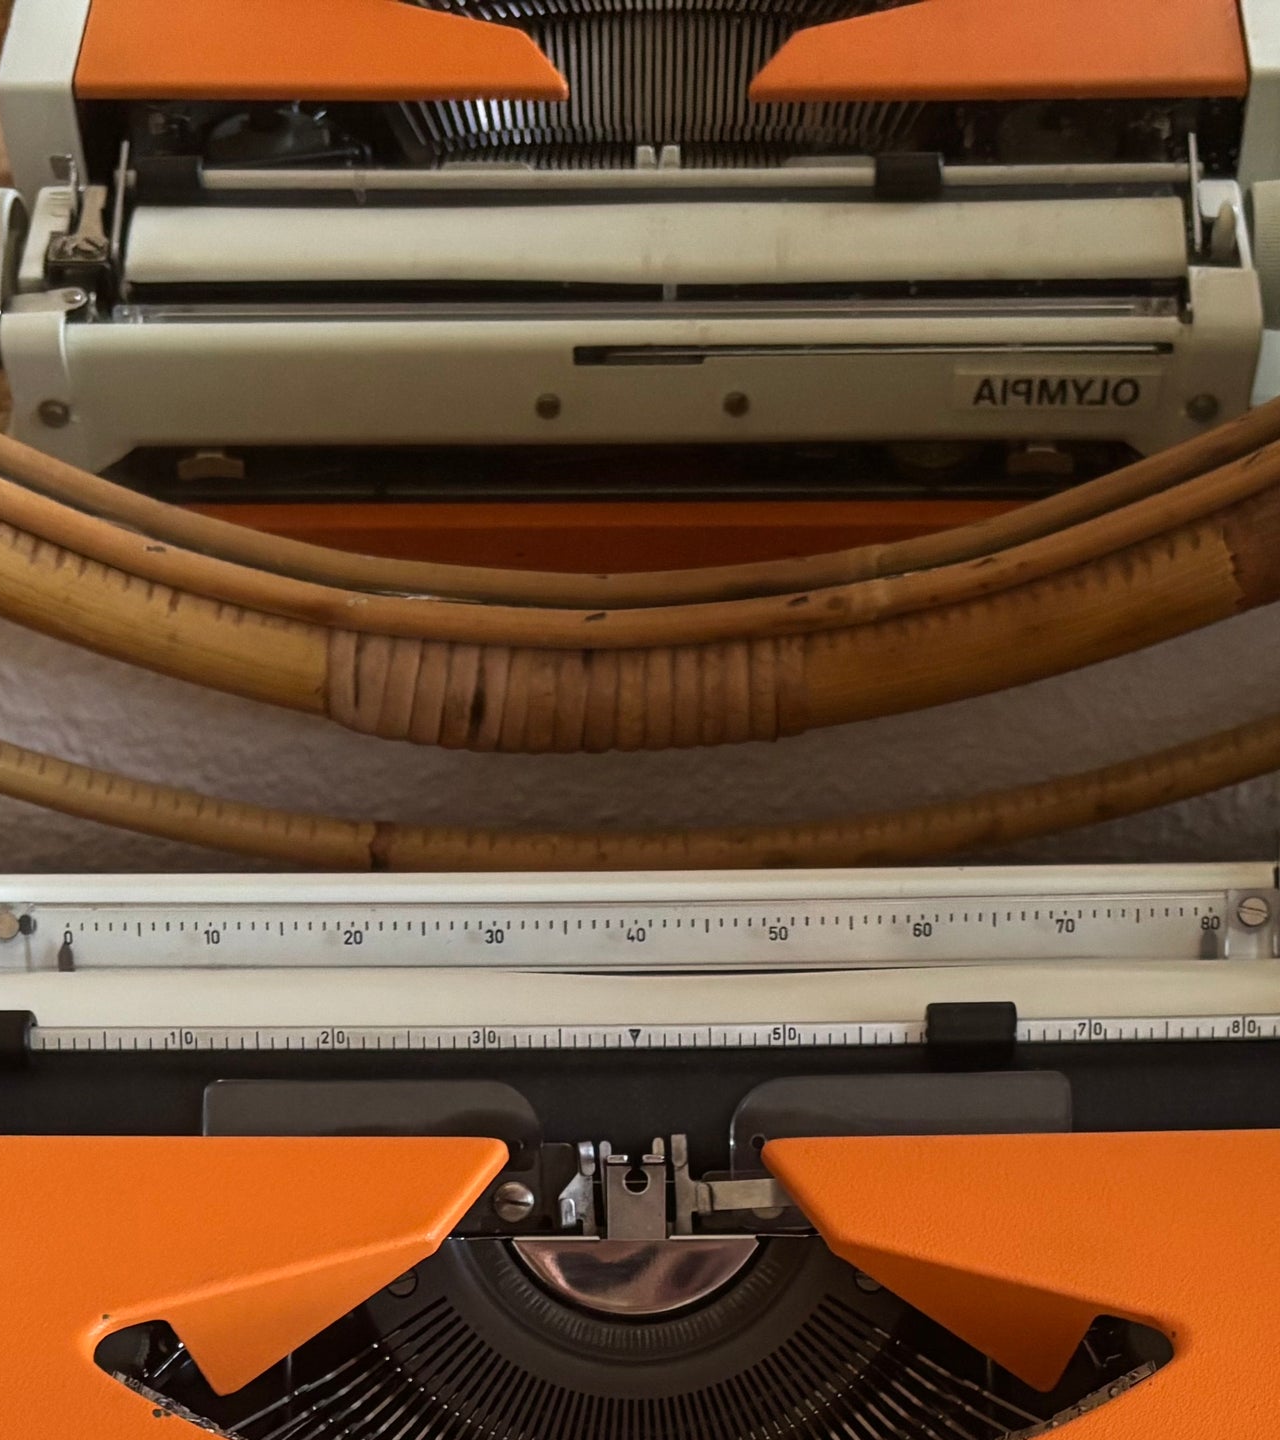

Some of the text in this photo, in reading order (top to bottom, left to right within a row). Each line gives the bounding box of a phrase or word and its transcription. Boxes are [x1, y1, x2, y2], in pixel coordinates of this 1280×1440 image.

[63, 916, 1221, 945] 0 10 20 30 40 50 60 70 80
[170, 1020, 1256, 1045] 10 20 30 50 70 80
